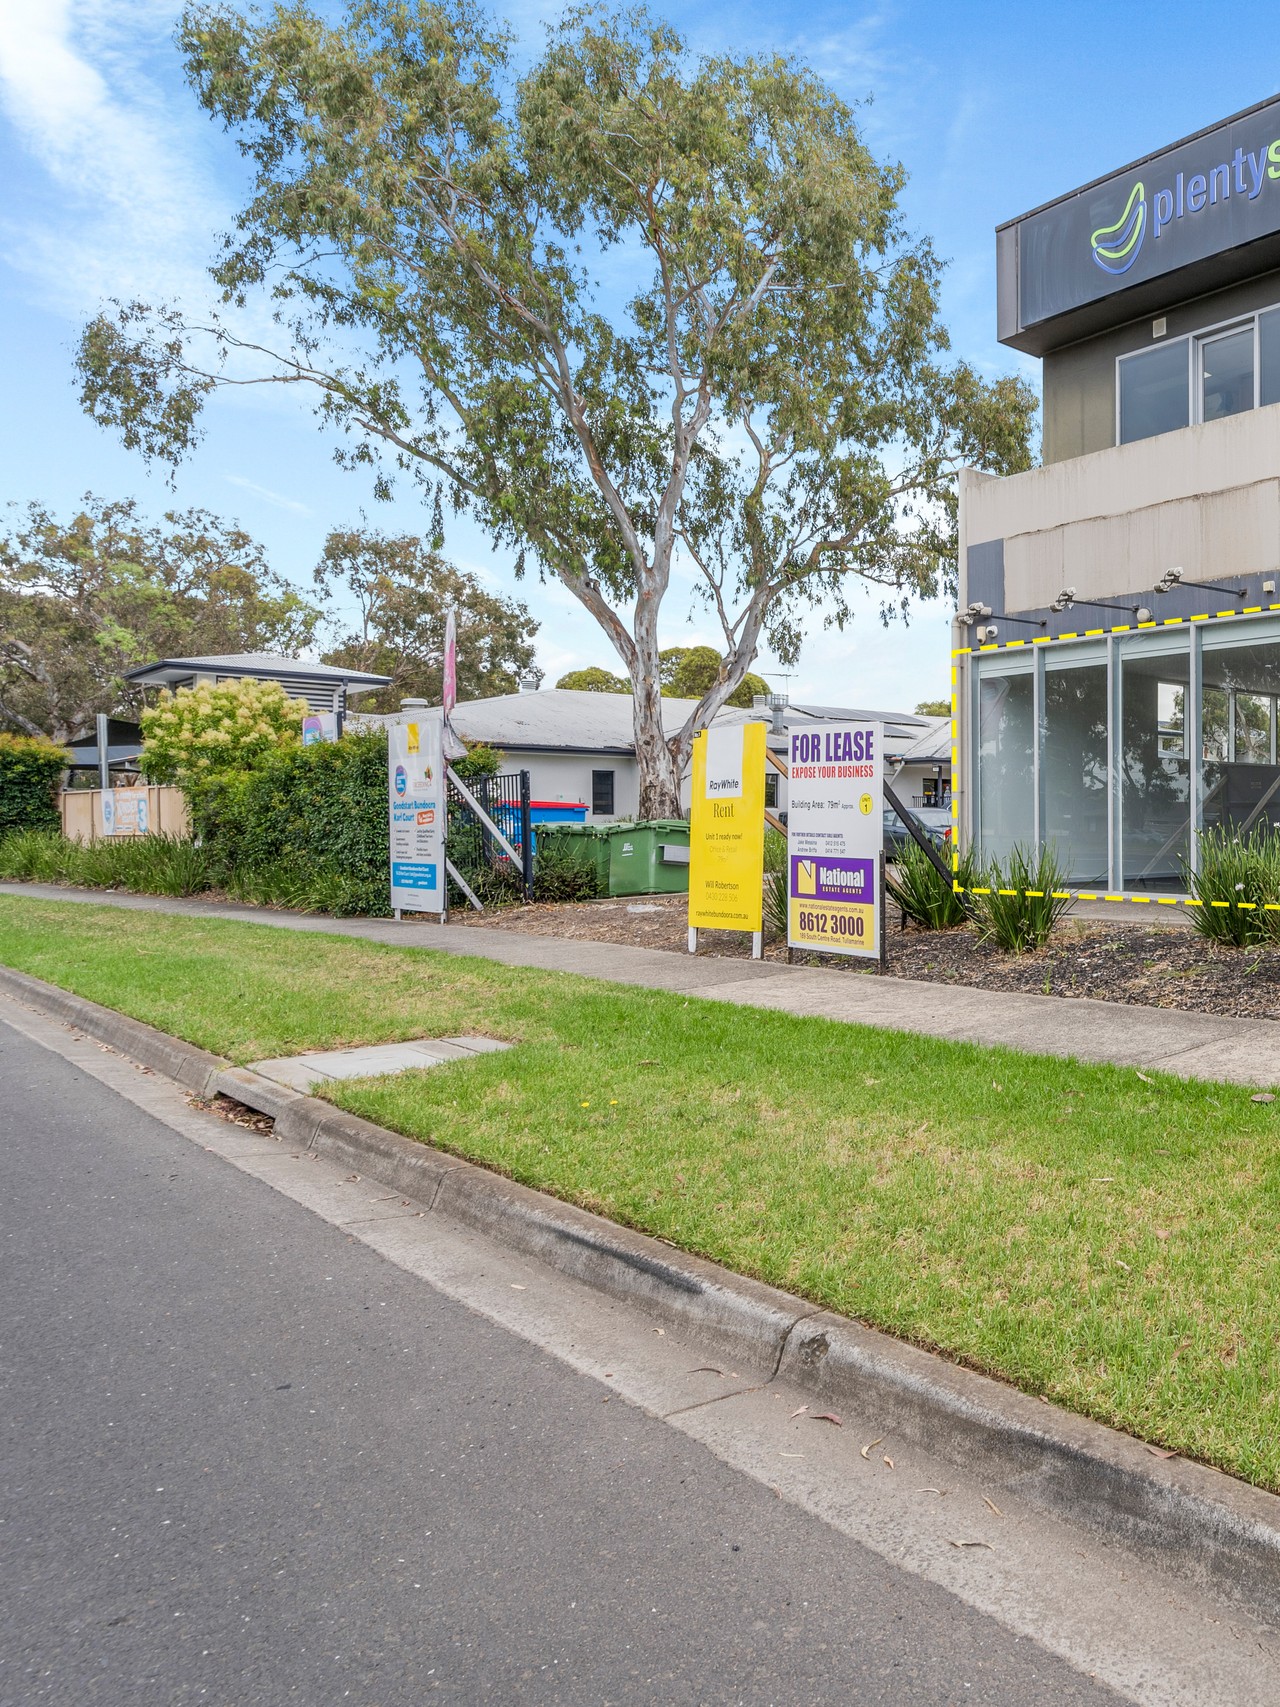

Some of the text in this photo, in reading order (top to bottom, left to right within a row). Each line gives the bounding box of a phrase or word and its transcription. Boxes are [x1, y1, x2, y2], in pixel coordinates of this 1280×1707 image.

[792, 730, 874, 763] FOR LEASE
[792, 764, 874, 778] EXPOSE YOUR BUSINESS
[713, 802, 734, 818] Rent
[792, 800, 810, 810] Building
[864, 804, 868, 812] 1
[719, 832, 730, 840] ready
[820, 866, 864, 887] National
[705, 880, 739, 890] Will Robertson
[800, 911, 864, 937] 8612 3000
